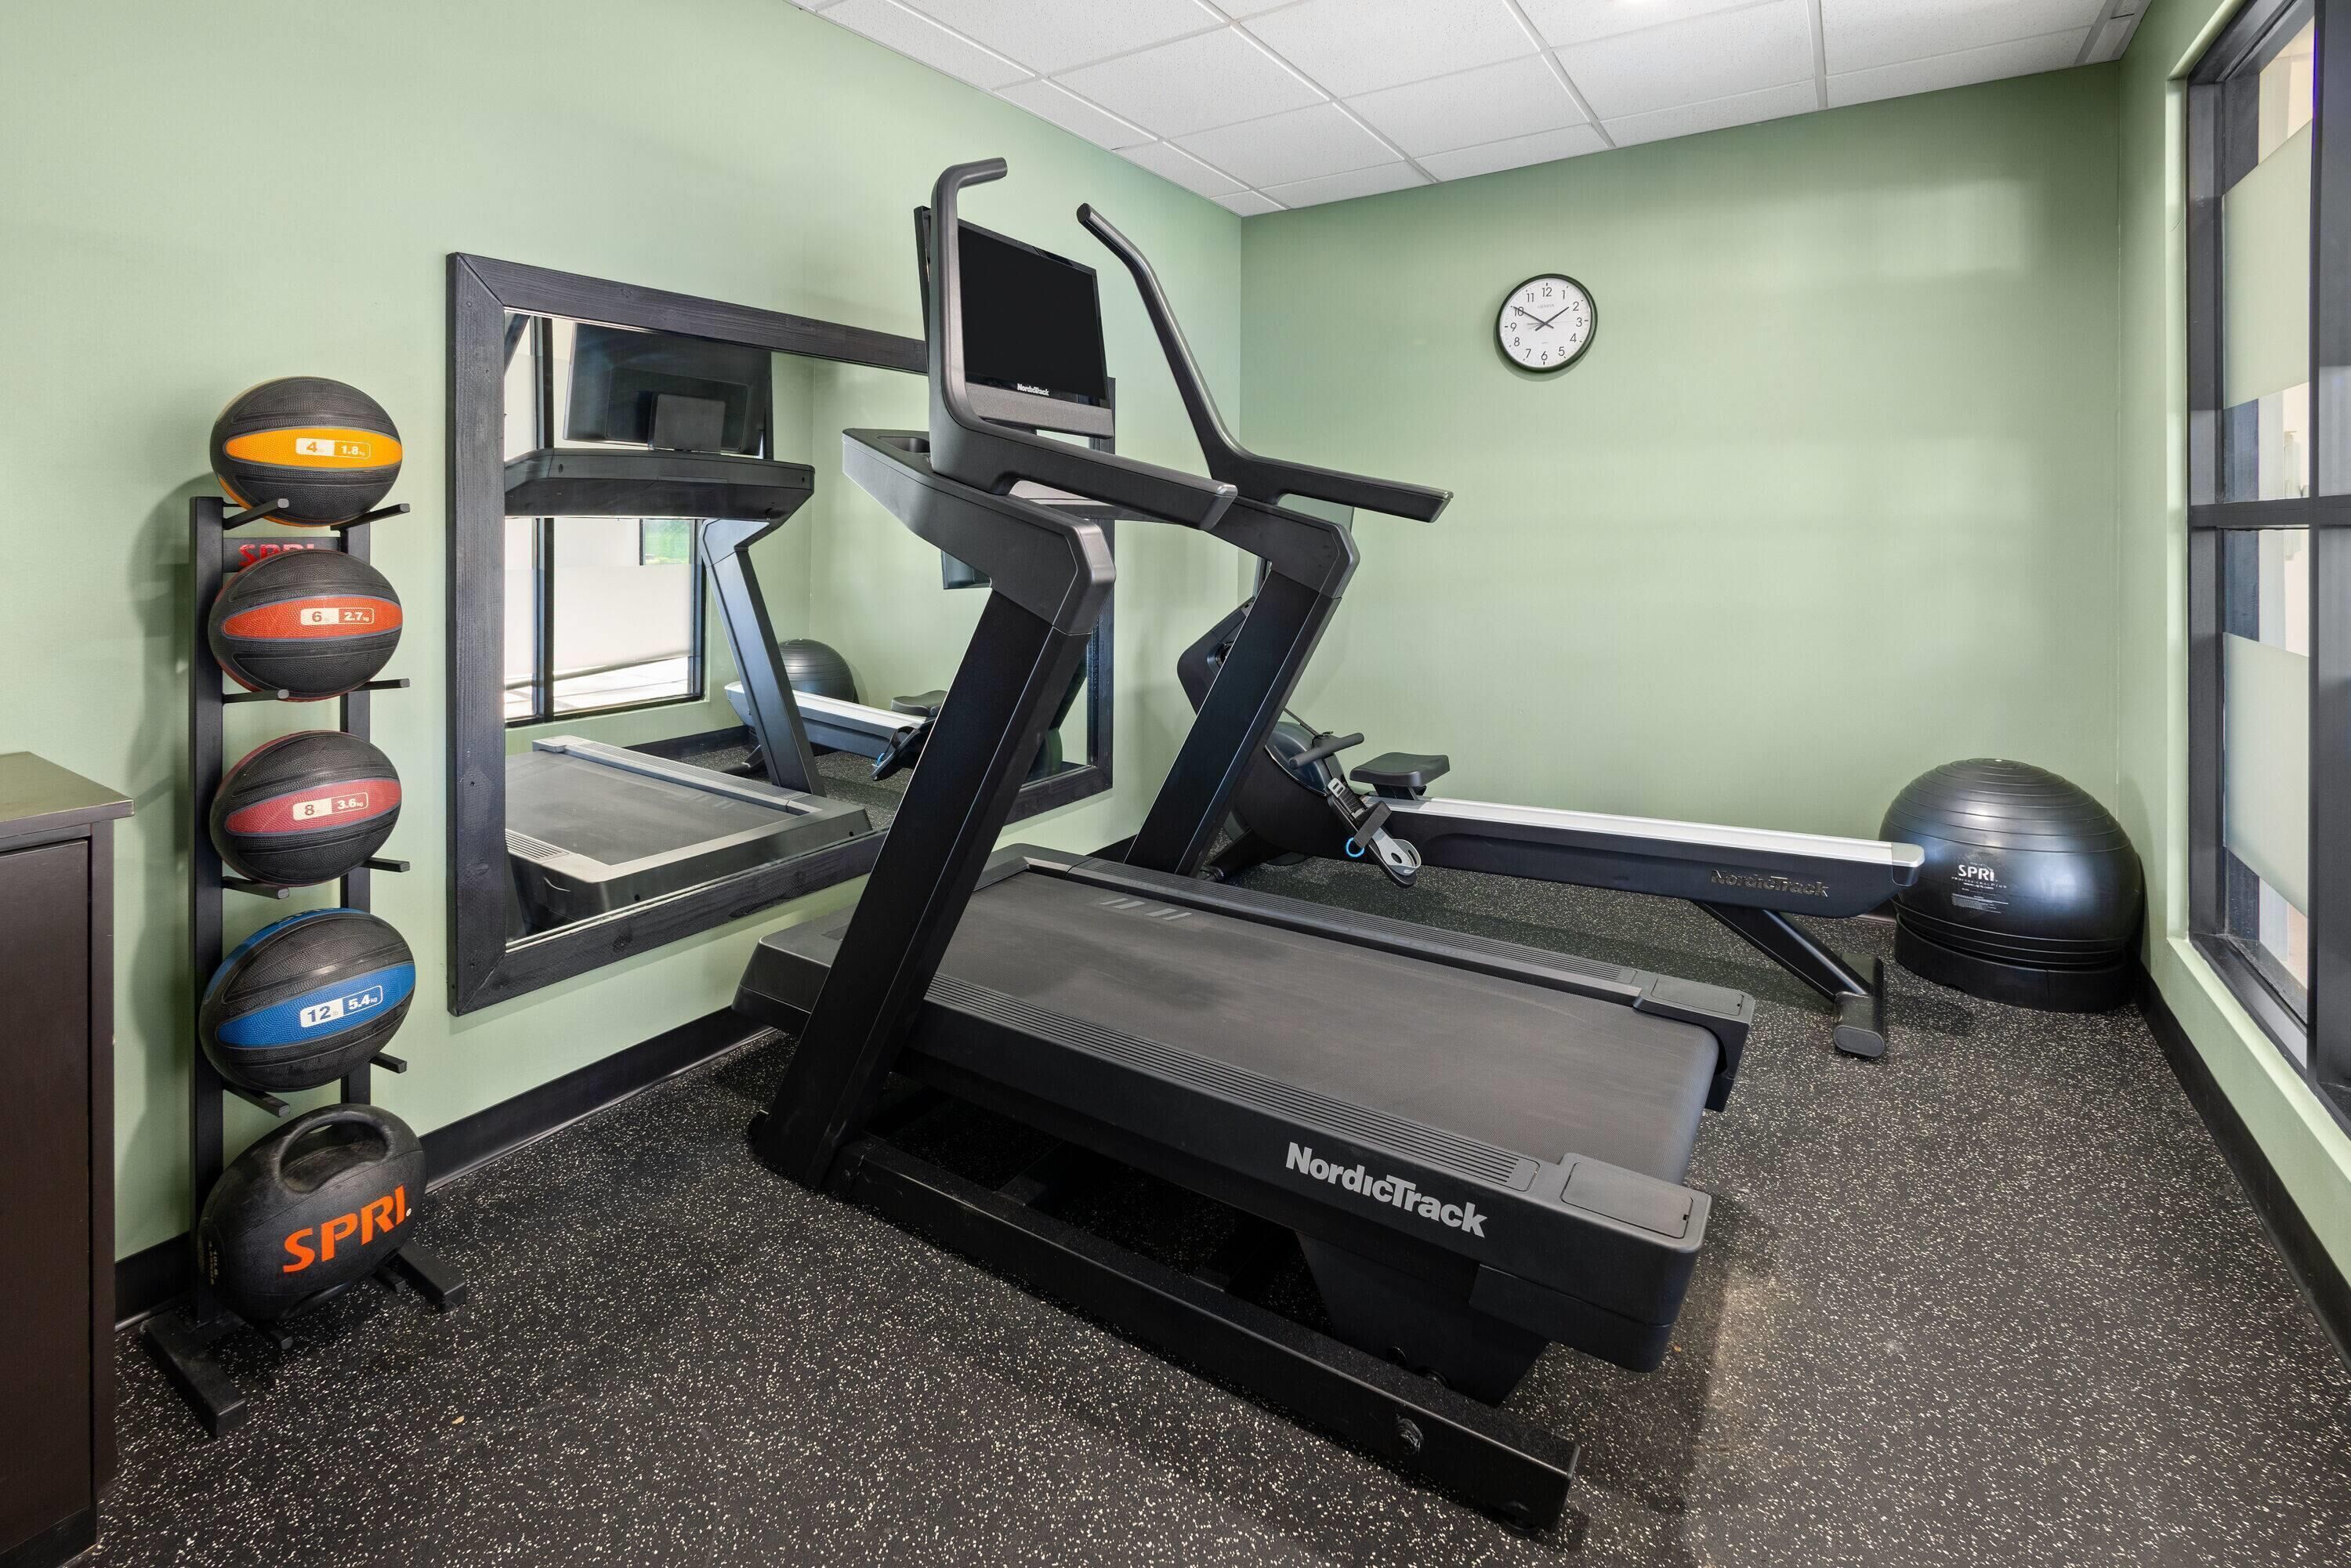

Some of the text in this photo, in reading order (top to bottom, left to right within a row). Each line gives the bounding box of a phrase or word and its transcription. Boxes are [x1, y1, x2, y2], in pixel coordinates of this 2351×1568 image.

[1527, 292, 1534, 302] 11
[1541, 287, 1552, 297] 12
[1562, 289, 1566, 299] 1
[1514, 306, 1524, 317] 10
[1572, 301, 1580, 311] 2
[1510, 322, 1517, 332] 9
[1575, 317, 1583, 327] 3
[1513, 337, 1520, 346] 8
[1570, 333, 1577, 342] 4
[1525, 348, 1531, 359] 7
[1541, 350, 1548, 360] 6
[1558, 346, 1565, 357] 5
[1017, 382, 1049, 396] NordicTrack
[306, 441, 317, 452] 4
[238, 544, 314, 567] SP
[312, 610, 322, 622] 6
[304, 804, 315, 816] 8
[1958, 864, 1994, 882] SPRI
[1711, 869, 1830, 897] NordicTrack
[307, 1005, 331, 1023] 12
[1285, 1141, 1488, 1239] NordicTrack
[282, 1183, 406, 1273] SPRI
